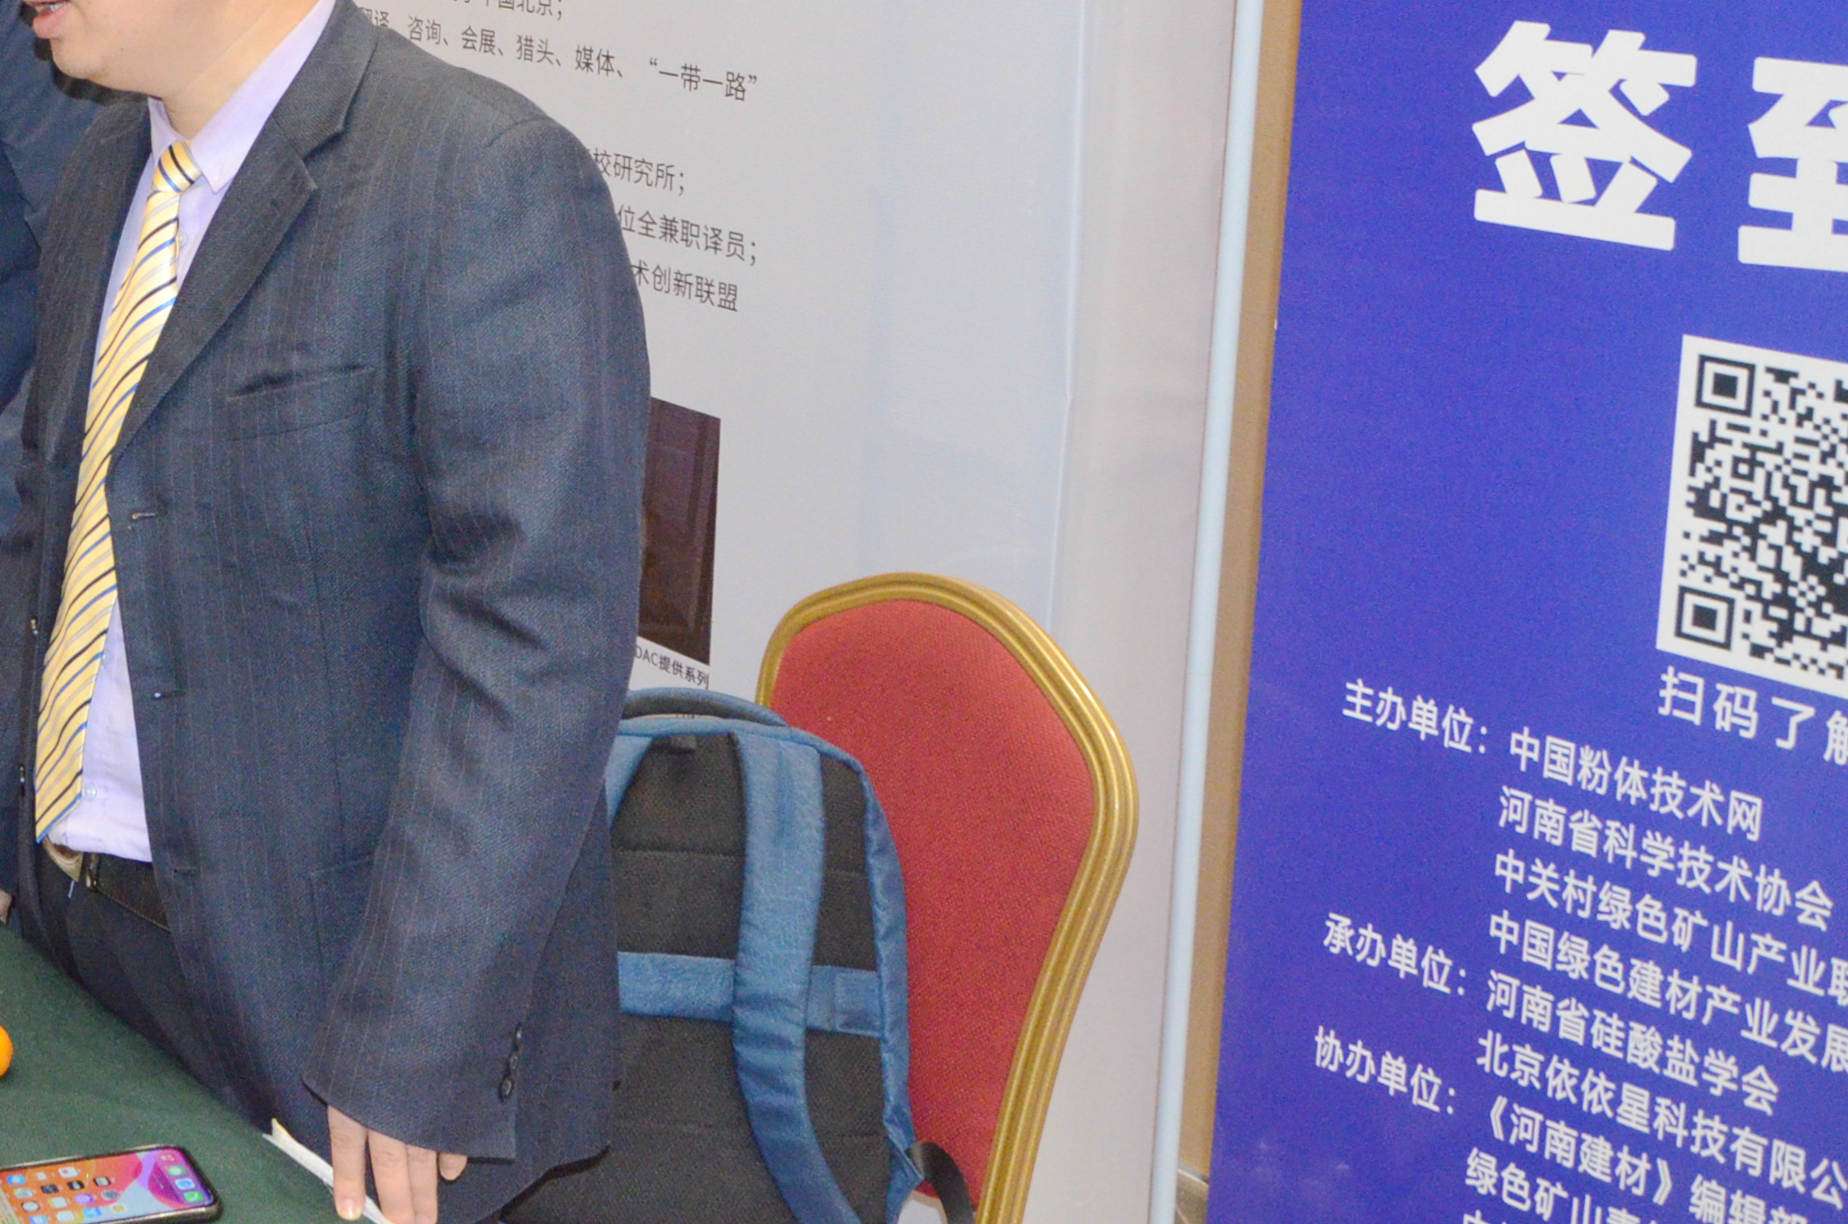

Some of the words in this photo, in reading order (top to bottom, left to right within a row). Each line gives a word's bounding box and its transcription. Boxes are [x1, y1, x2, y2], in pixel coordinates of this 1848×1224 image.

[1342, 678, 1488, 754] 主办单位：
[1509, 726, 1763, 842] 中国粉体技术网
[1498, 785, 1834, 931] 河南省科学技术协会
[1314, 1025, 1456, 1115] 协办单位：
[1322, 912, 1467, 996] 承办单位：
[1486, 969, 1779, 1116] 河南省硅酸盐学会
[1464, 1147, 1657, 1224] 绿色矿山
[1476, 1029, 1848, 1211] 北京依依星科技有限公
